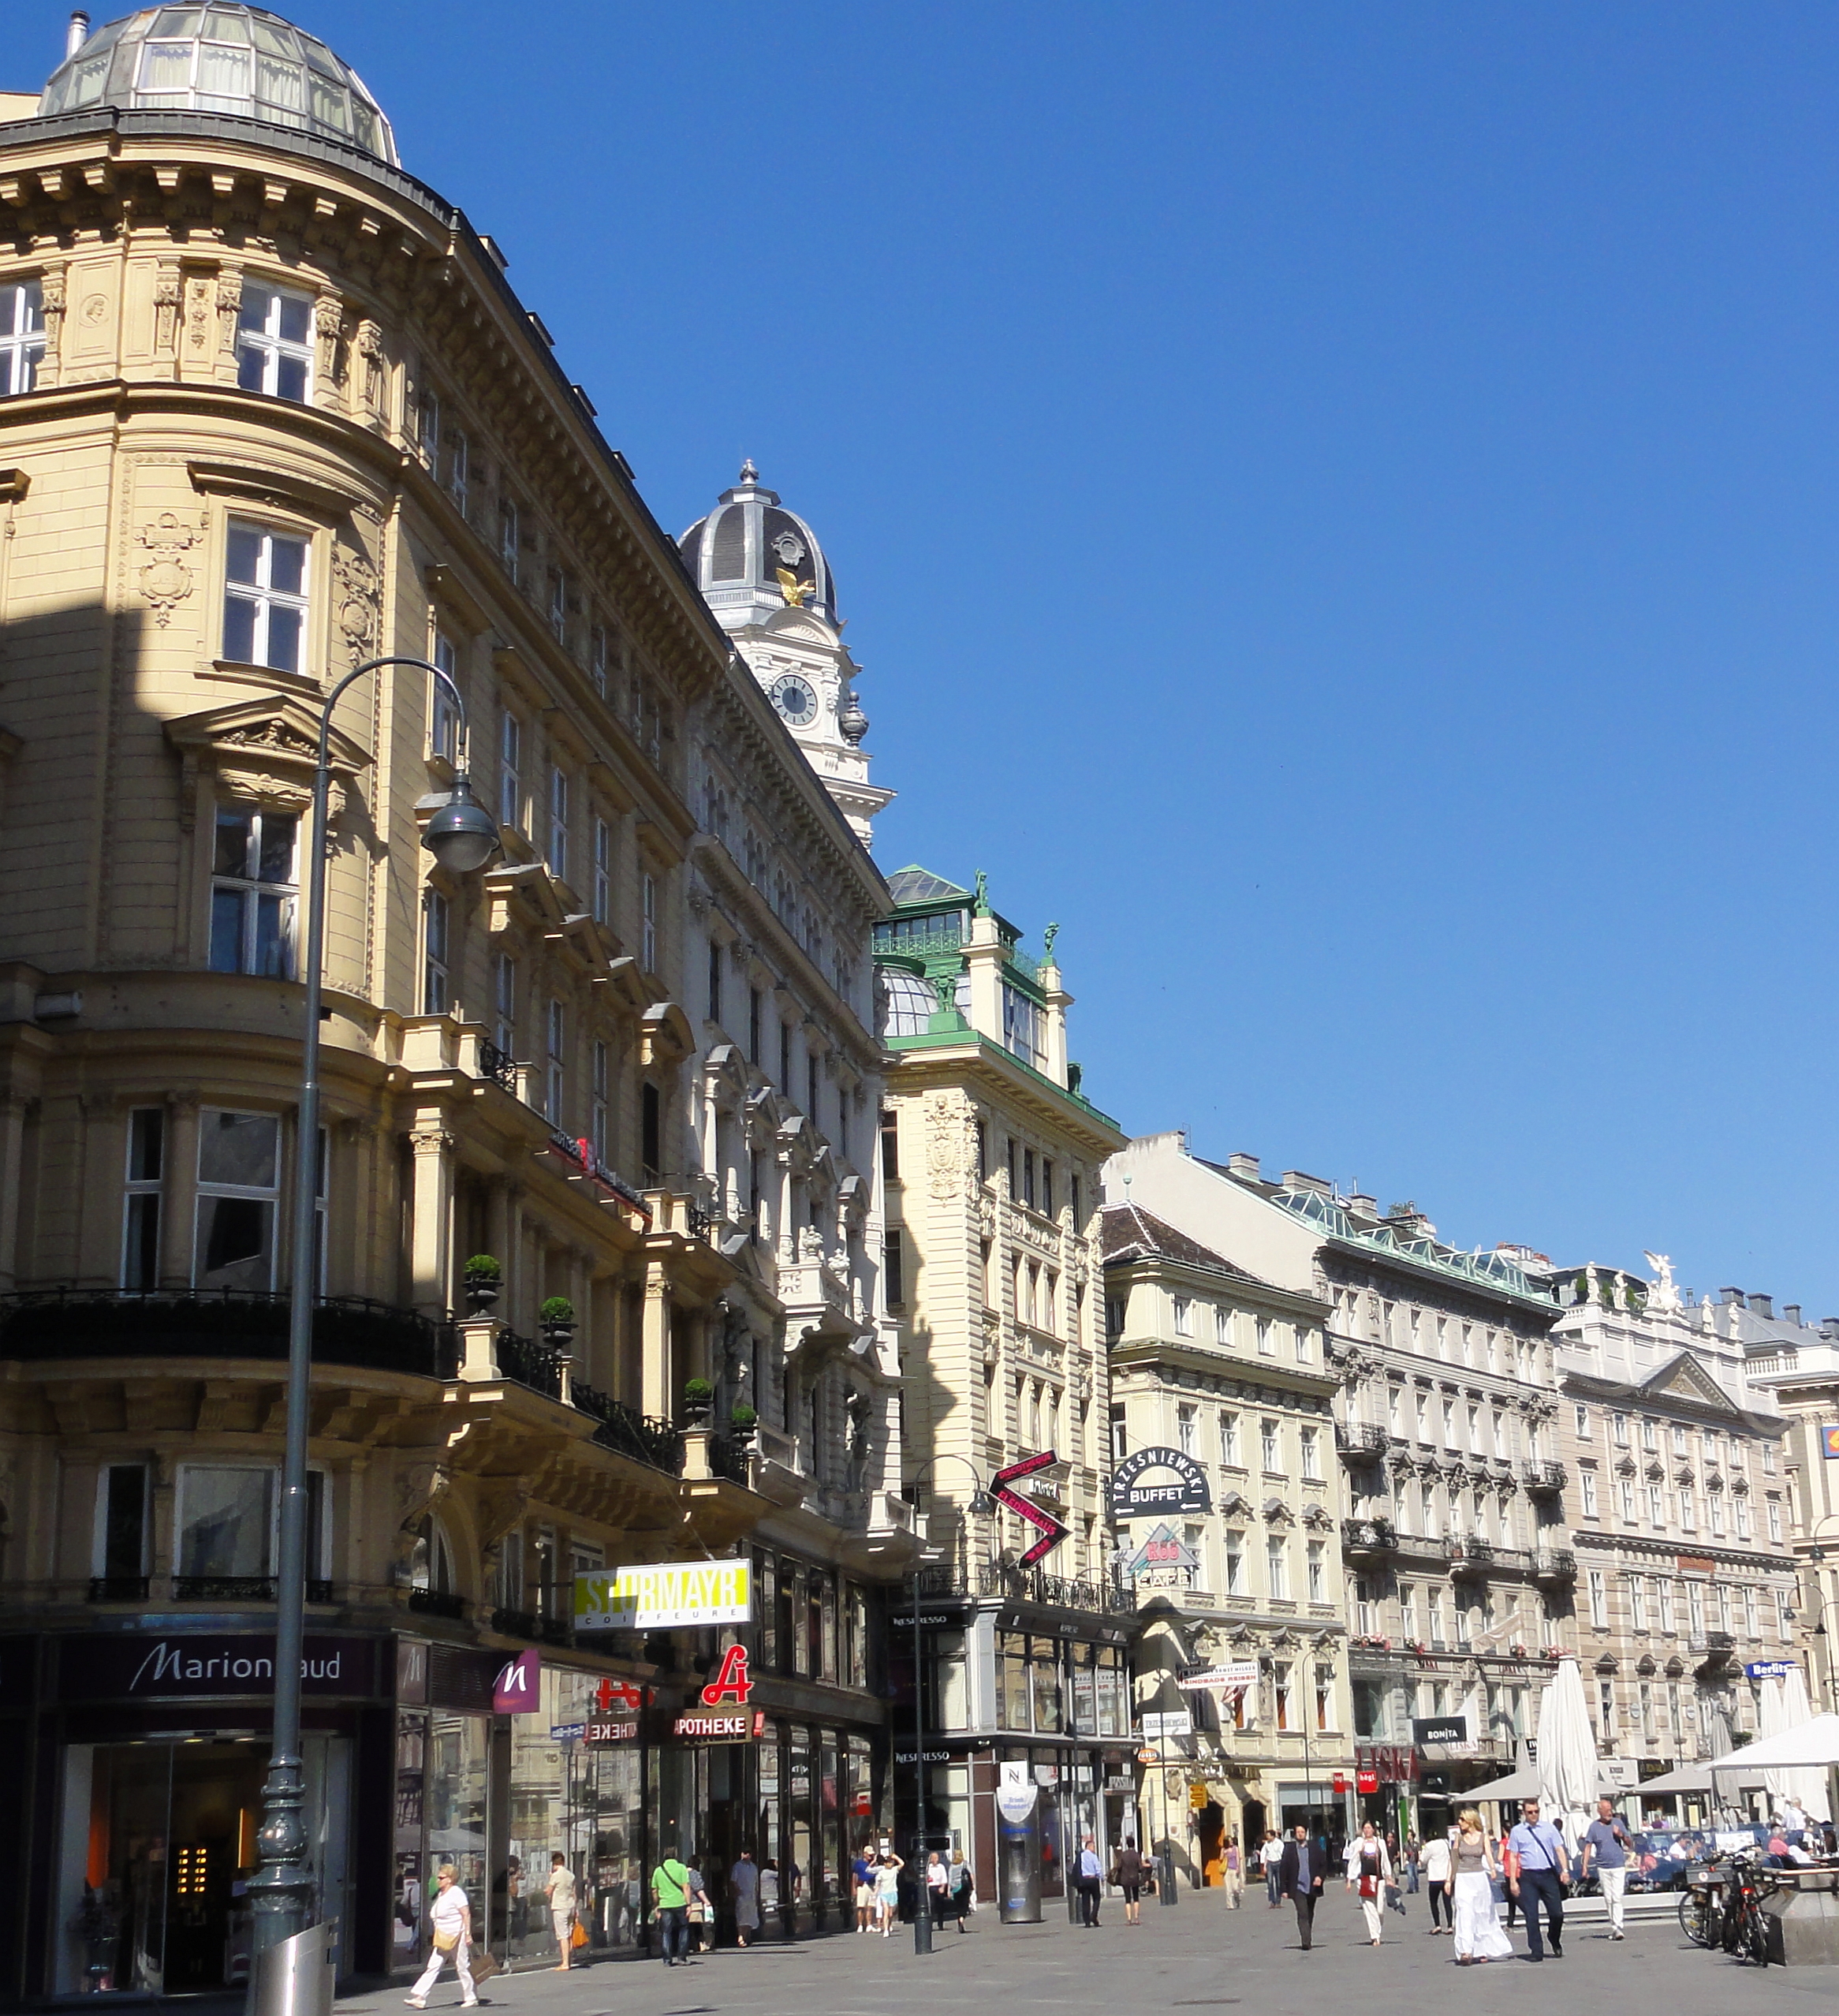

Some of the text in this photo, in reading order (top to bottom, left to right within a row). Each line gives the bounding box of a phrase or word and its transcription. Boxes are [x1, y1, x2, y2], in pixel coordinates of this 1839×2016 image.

[998, 1453, 1052, 1479] DISCOTHEQUE
[1113, 1450, 1203, 1502] TRZESNIEWSKI
[1129, 1487, 1185, 1503] BUFFET
[998, 1491, 1057, 1536] FLEDERMAUS
[587, 1571, 738, 1614] STURMAYR
[1137, 1573, 1190, 1588] CAFE
[584, 1608, 737, 1625] COIFFEURE
[129, 1642, 341, 1691] Marionaud
[674, 1717, 746, 1734] APOTHEKE
